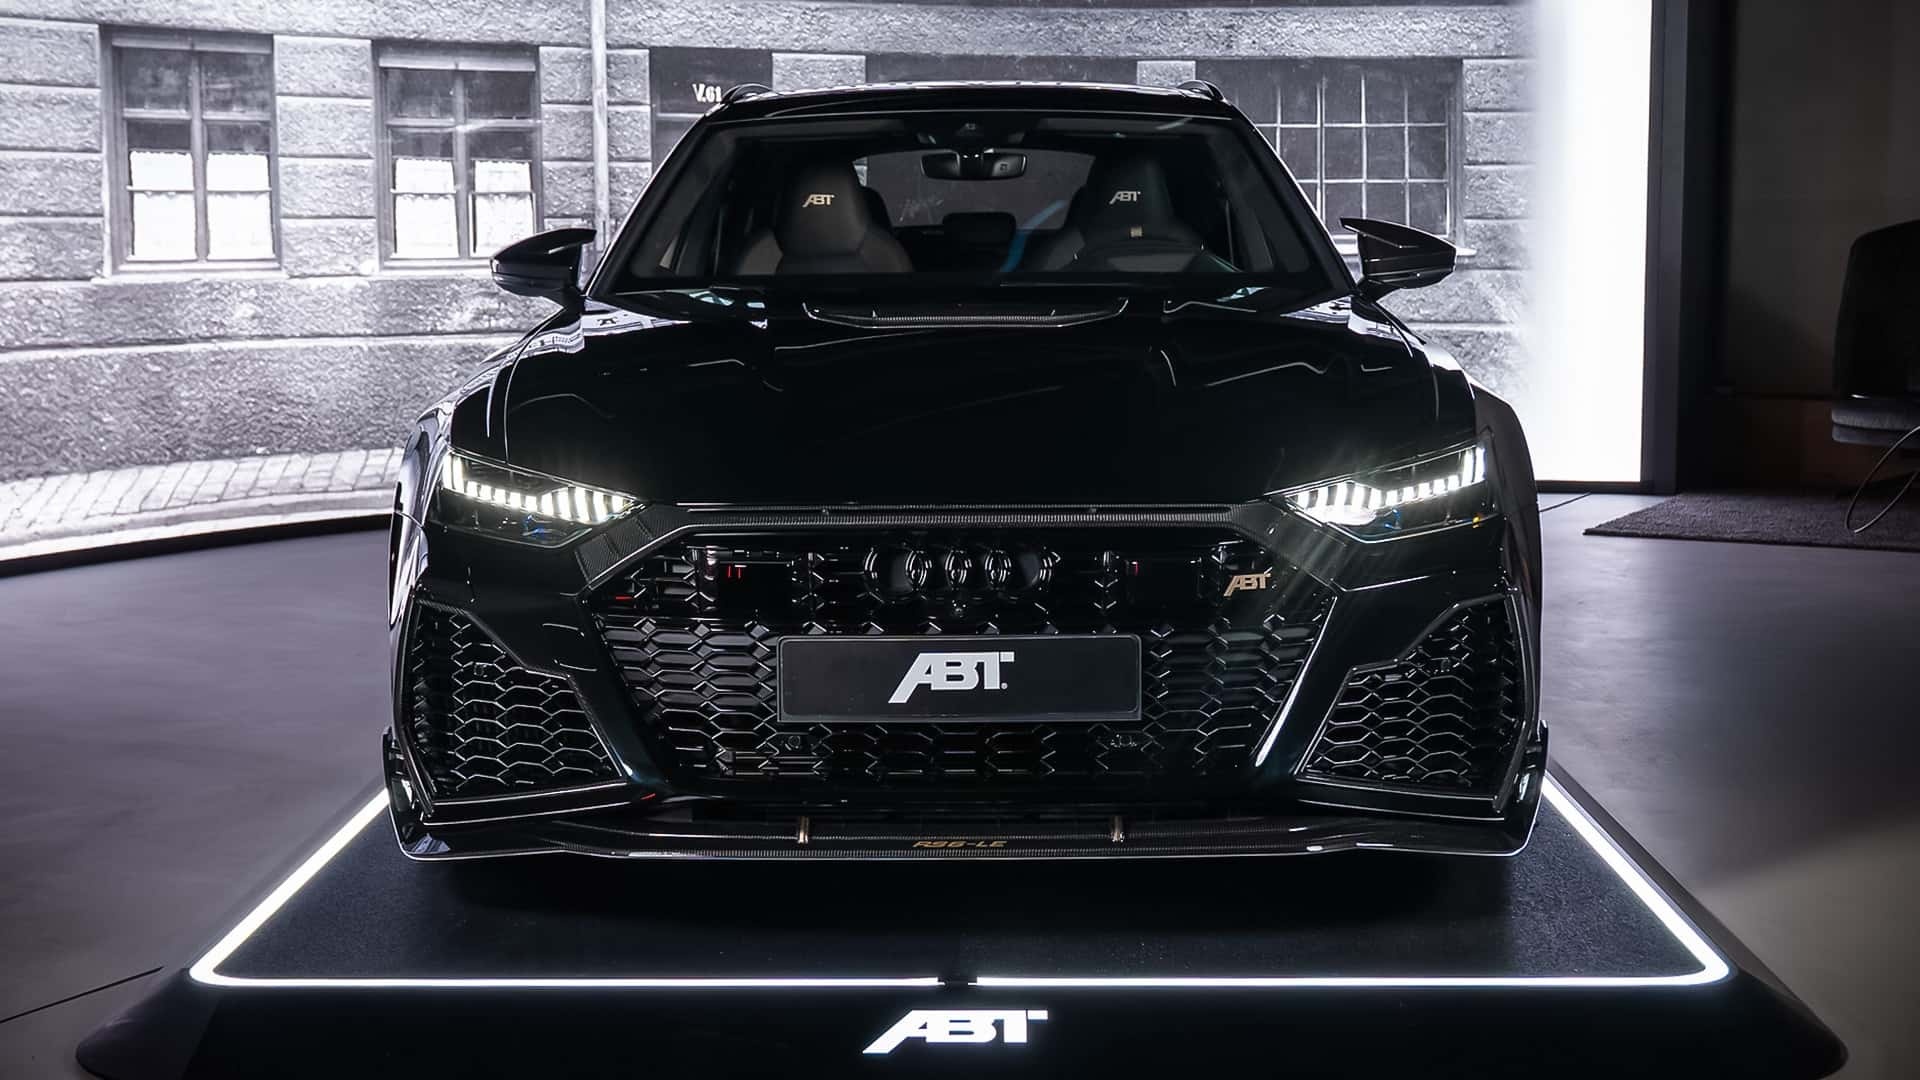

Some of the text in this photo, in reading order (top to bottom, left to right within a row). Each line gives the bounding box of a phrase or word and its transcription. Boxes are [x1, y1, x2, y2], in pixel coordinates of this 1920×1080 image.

[802, 194, 835, 208] ABT
[1109, 191, 1141, 205] ABT
[1223, 573, 1271, 597] ABT
[888, 651, 1015, 704] ABT
[862, 1009, 1048, 1054] ABT
